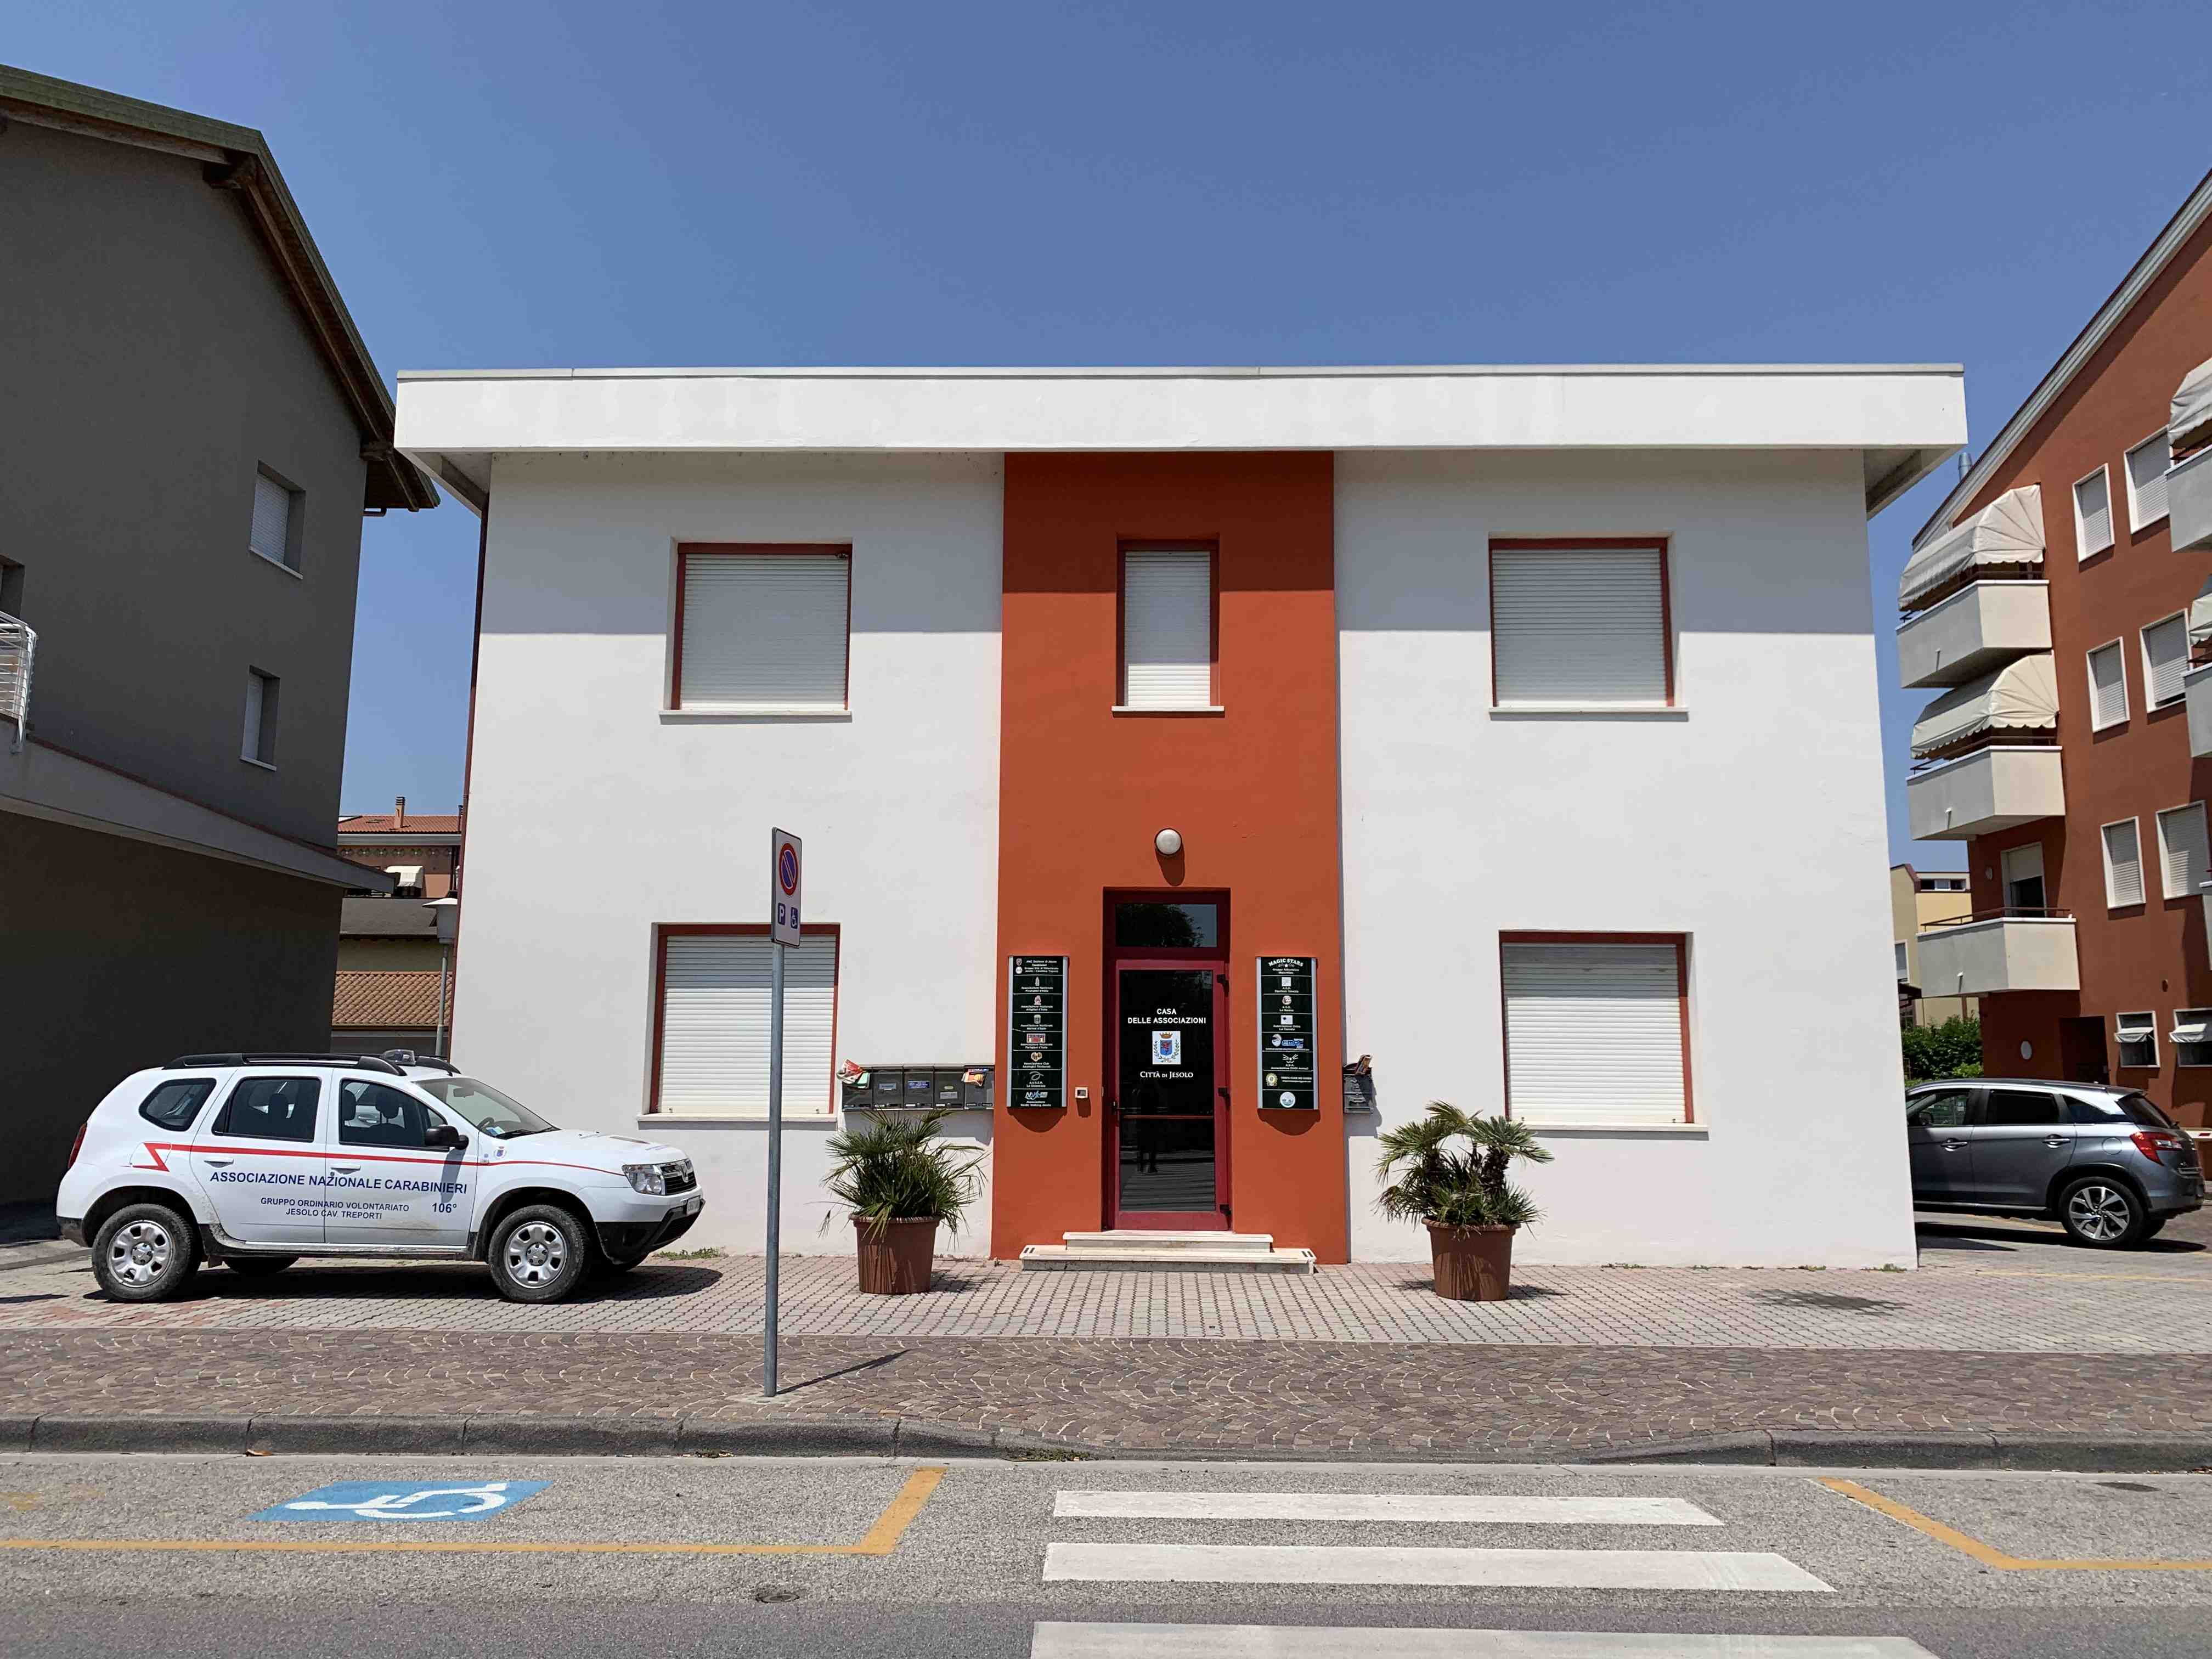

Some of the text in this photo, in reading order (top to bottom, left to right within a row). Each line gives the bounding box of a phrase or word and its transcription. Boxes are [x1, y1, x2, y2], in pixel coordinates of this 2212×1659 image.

[779, 905, 785, 922] P
[1268, 958, 1304, 967] MAGIC STARS
[210, 1172, 467, 1194] ASSOCIAZIONE NAZIONALE CARABINIERI
[261, 1198, 409, 1212] GRUPPO ORDINARIO VOLONTARIATO
[432, 1202, 457, 1213] 106°
